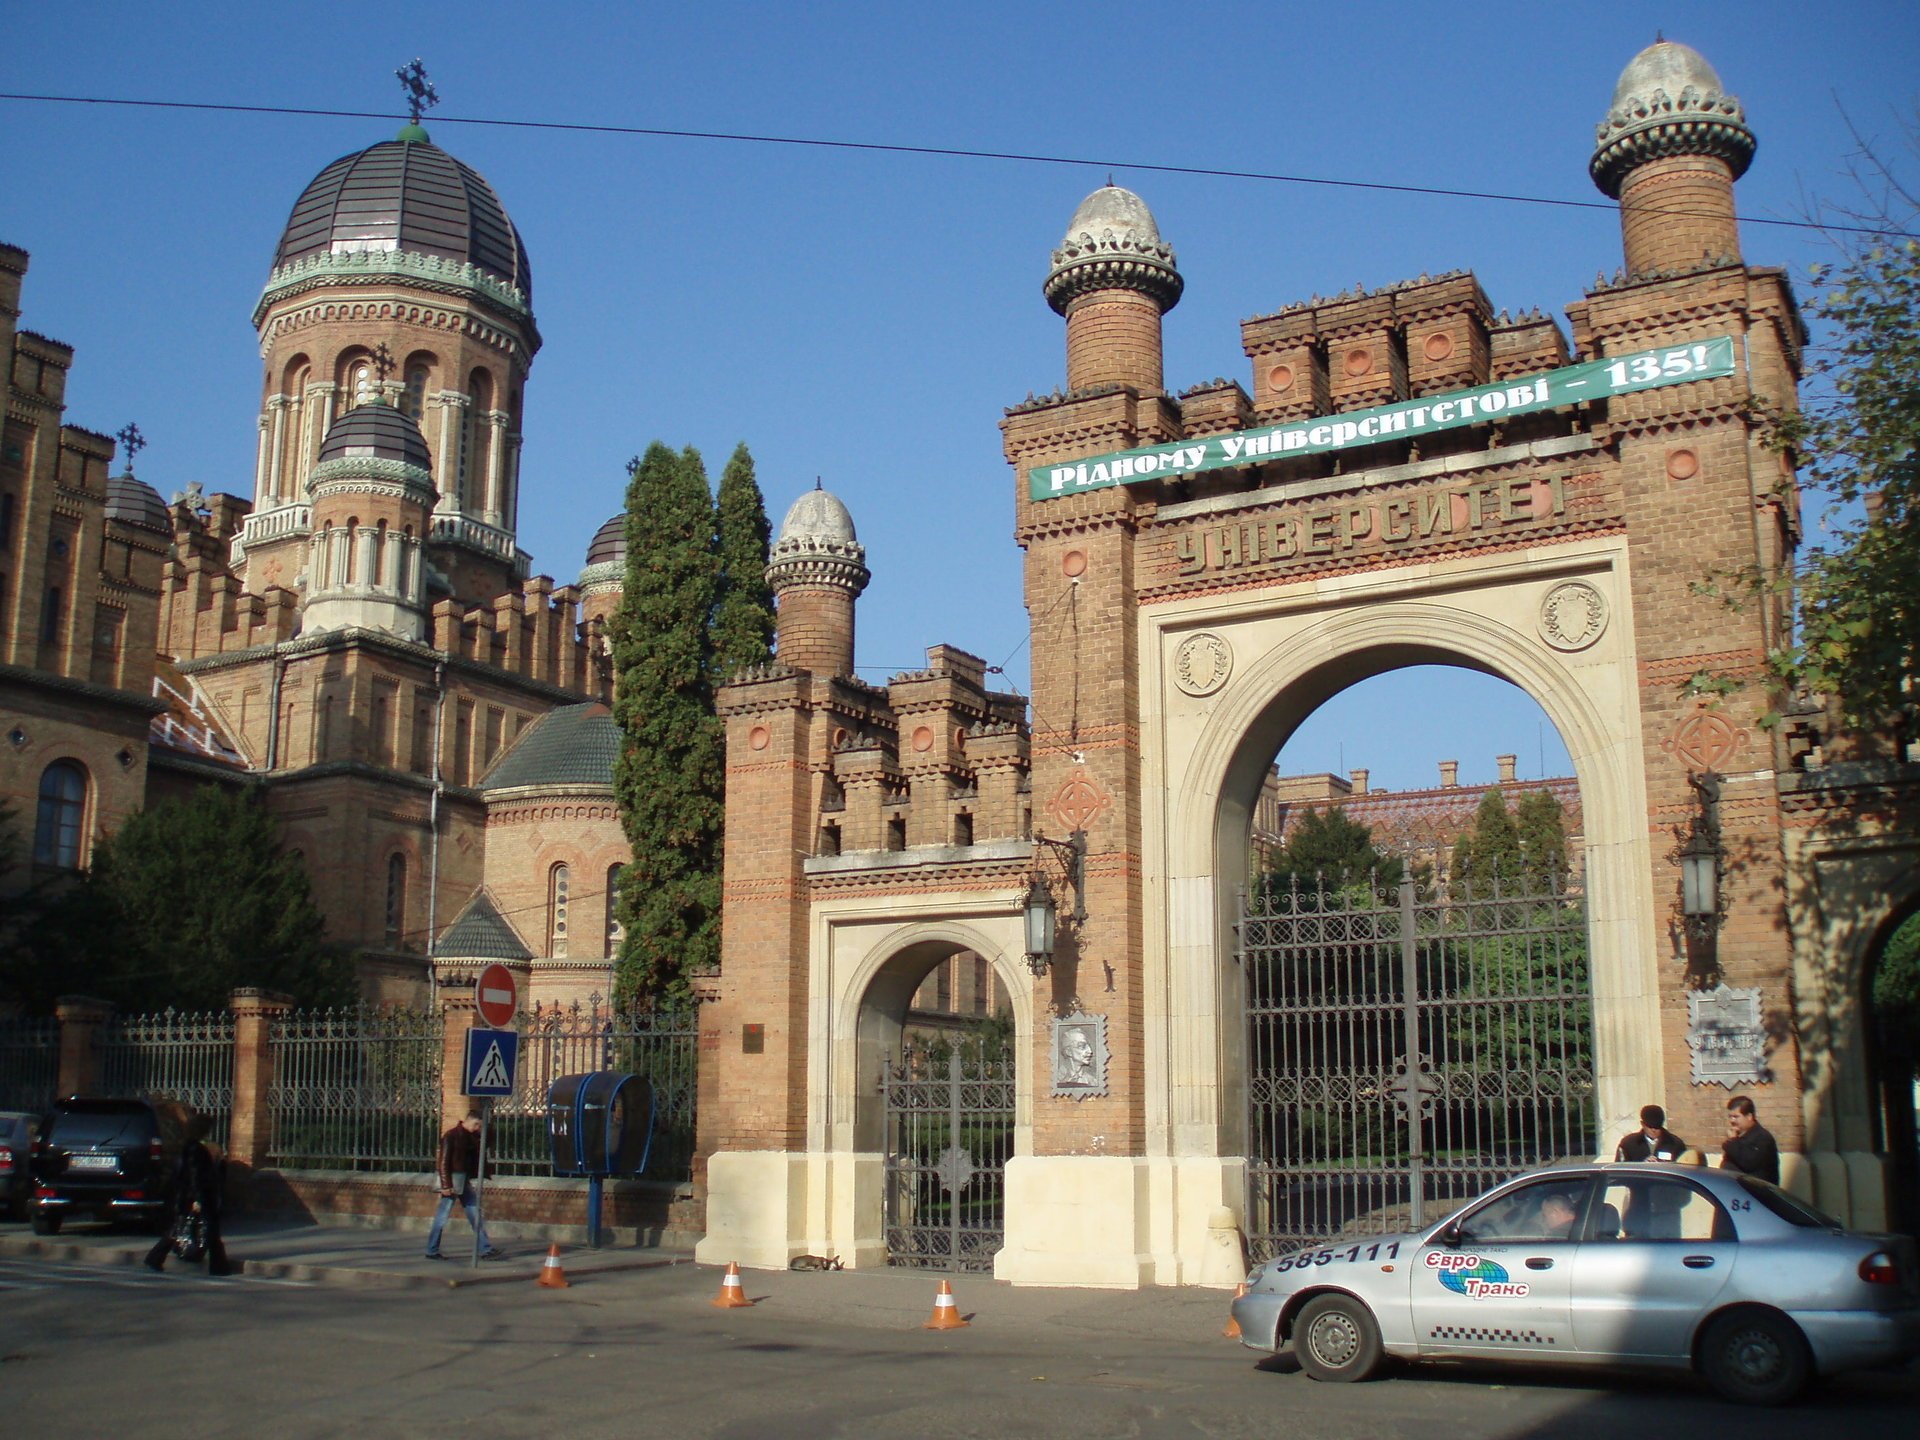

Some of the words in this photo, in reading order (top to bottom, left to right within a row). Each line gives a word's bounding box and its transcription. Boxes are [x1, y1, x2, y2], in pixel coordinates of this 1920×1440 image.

[1603, 345, 1708, 388] 135!
[1176, 470, 1573, 577] УНІВЕРСИТЕТ
[1731, 1199, 1751, 1213] 84
[1276, 1241, 1400, 1273] 585-111
[1425, 1252, 1478, 1270] Євро
[1466, 1280, 1528, 1298] Транс
